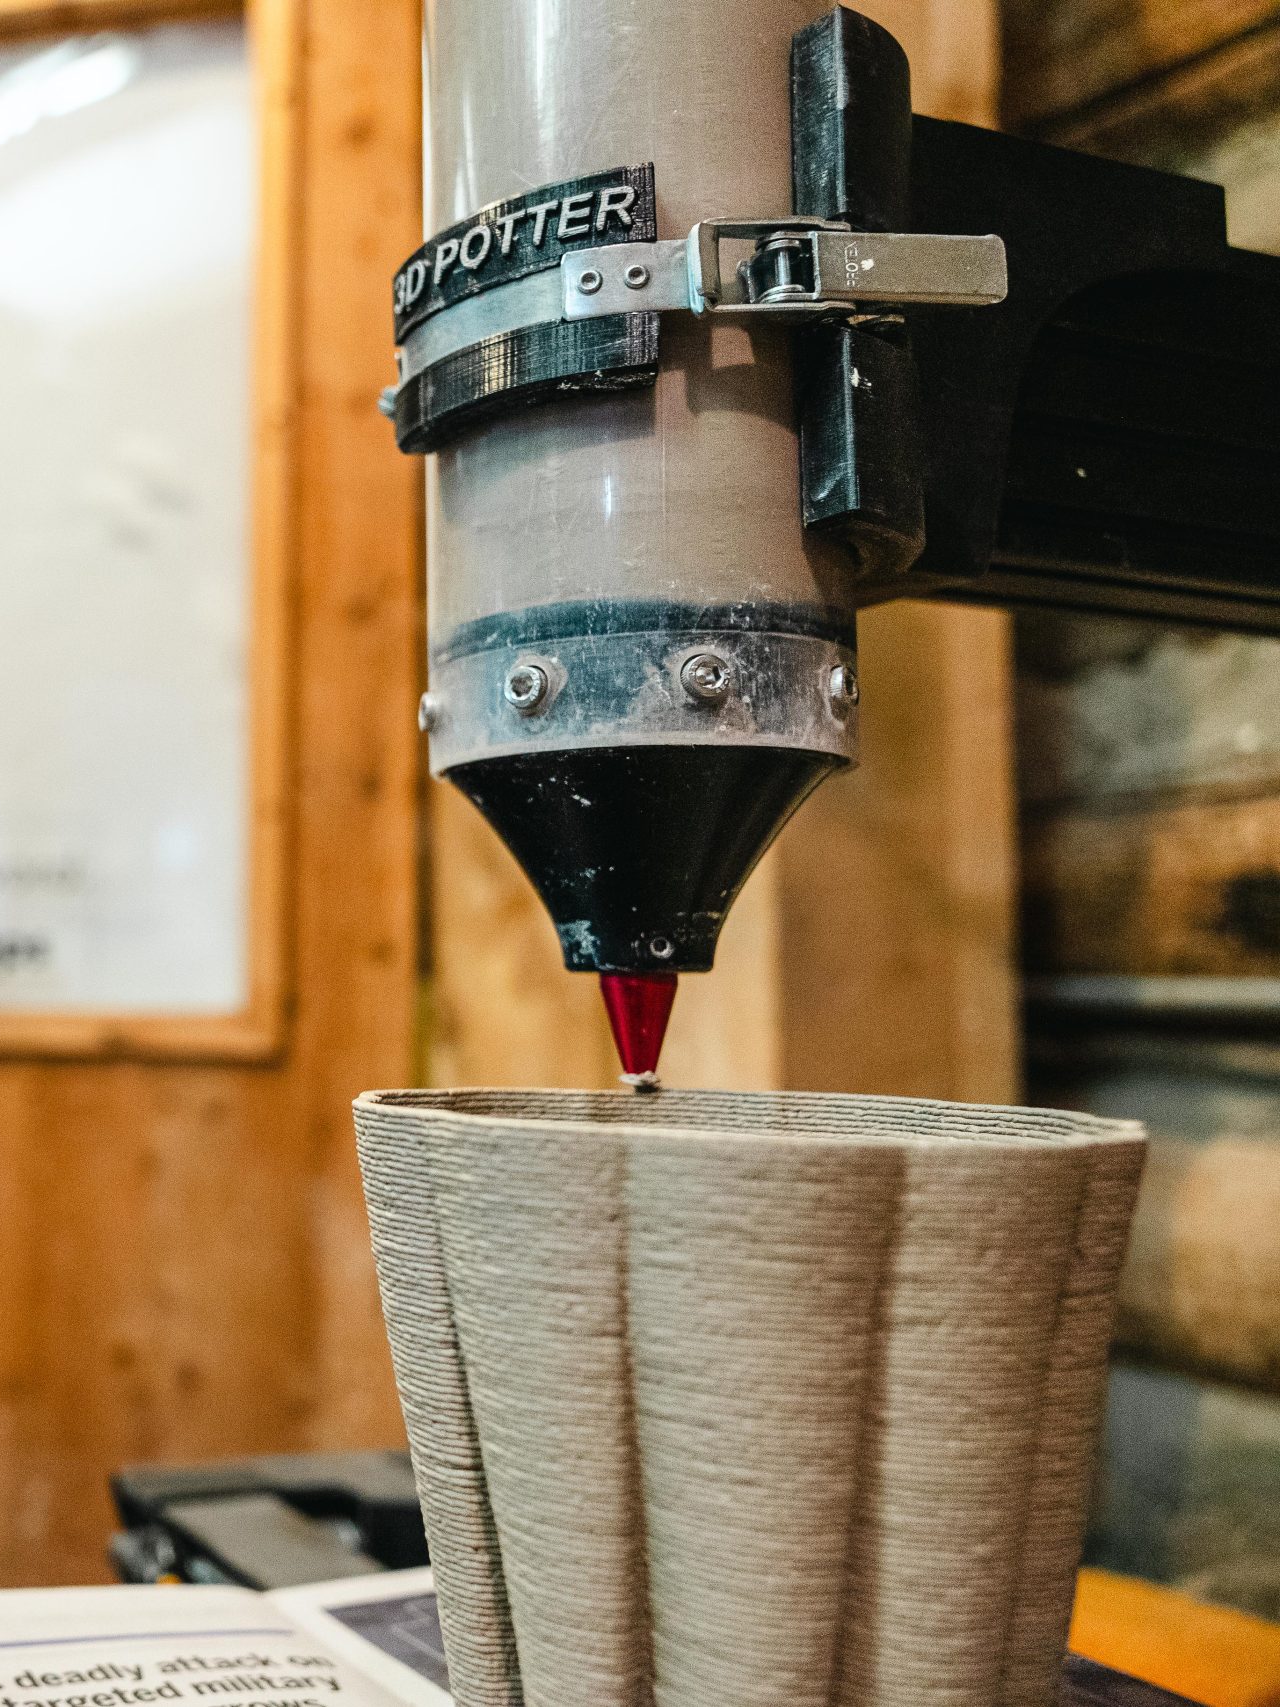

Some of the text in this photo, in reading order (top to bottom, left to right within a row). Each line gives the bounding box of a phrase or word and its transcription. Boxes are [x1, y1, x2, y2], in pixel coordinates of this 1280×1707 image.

[393, 184, 636, 315] 3D POTTER
[14, 1663, 144, 1689] deadly
[157, 1653, 280, 1674] attack
[190, 1673, 341, 1696] military
